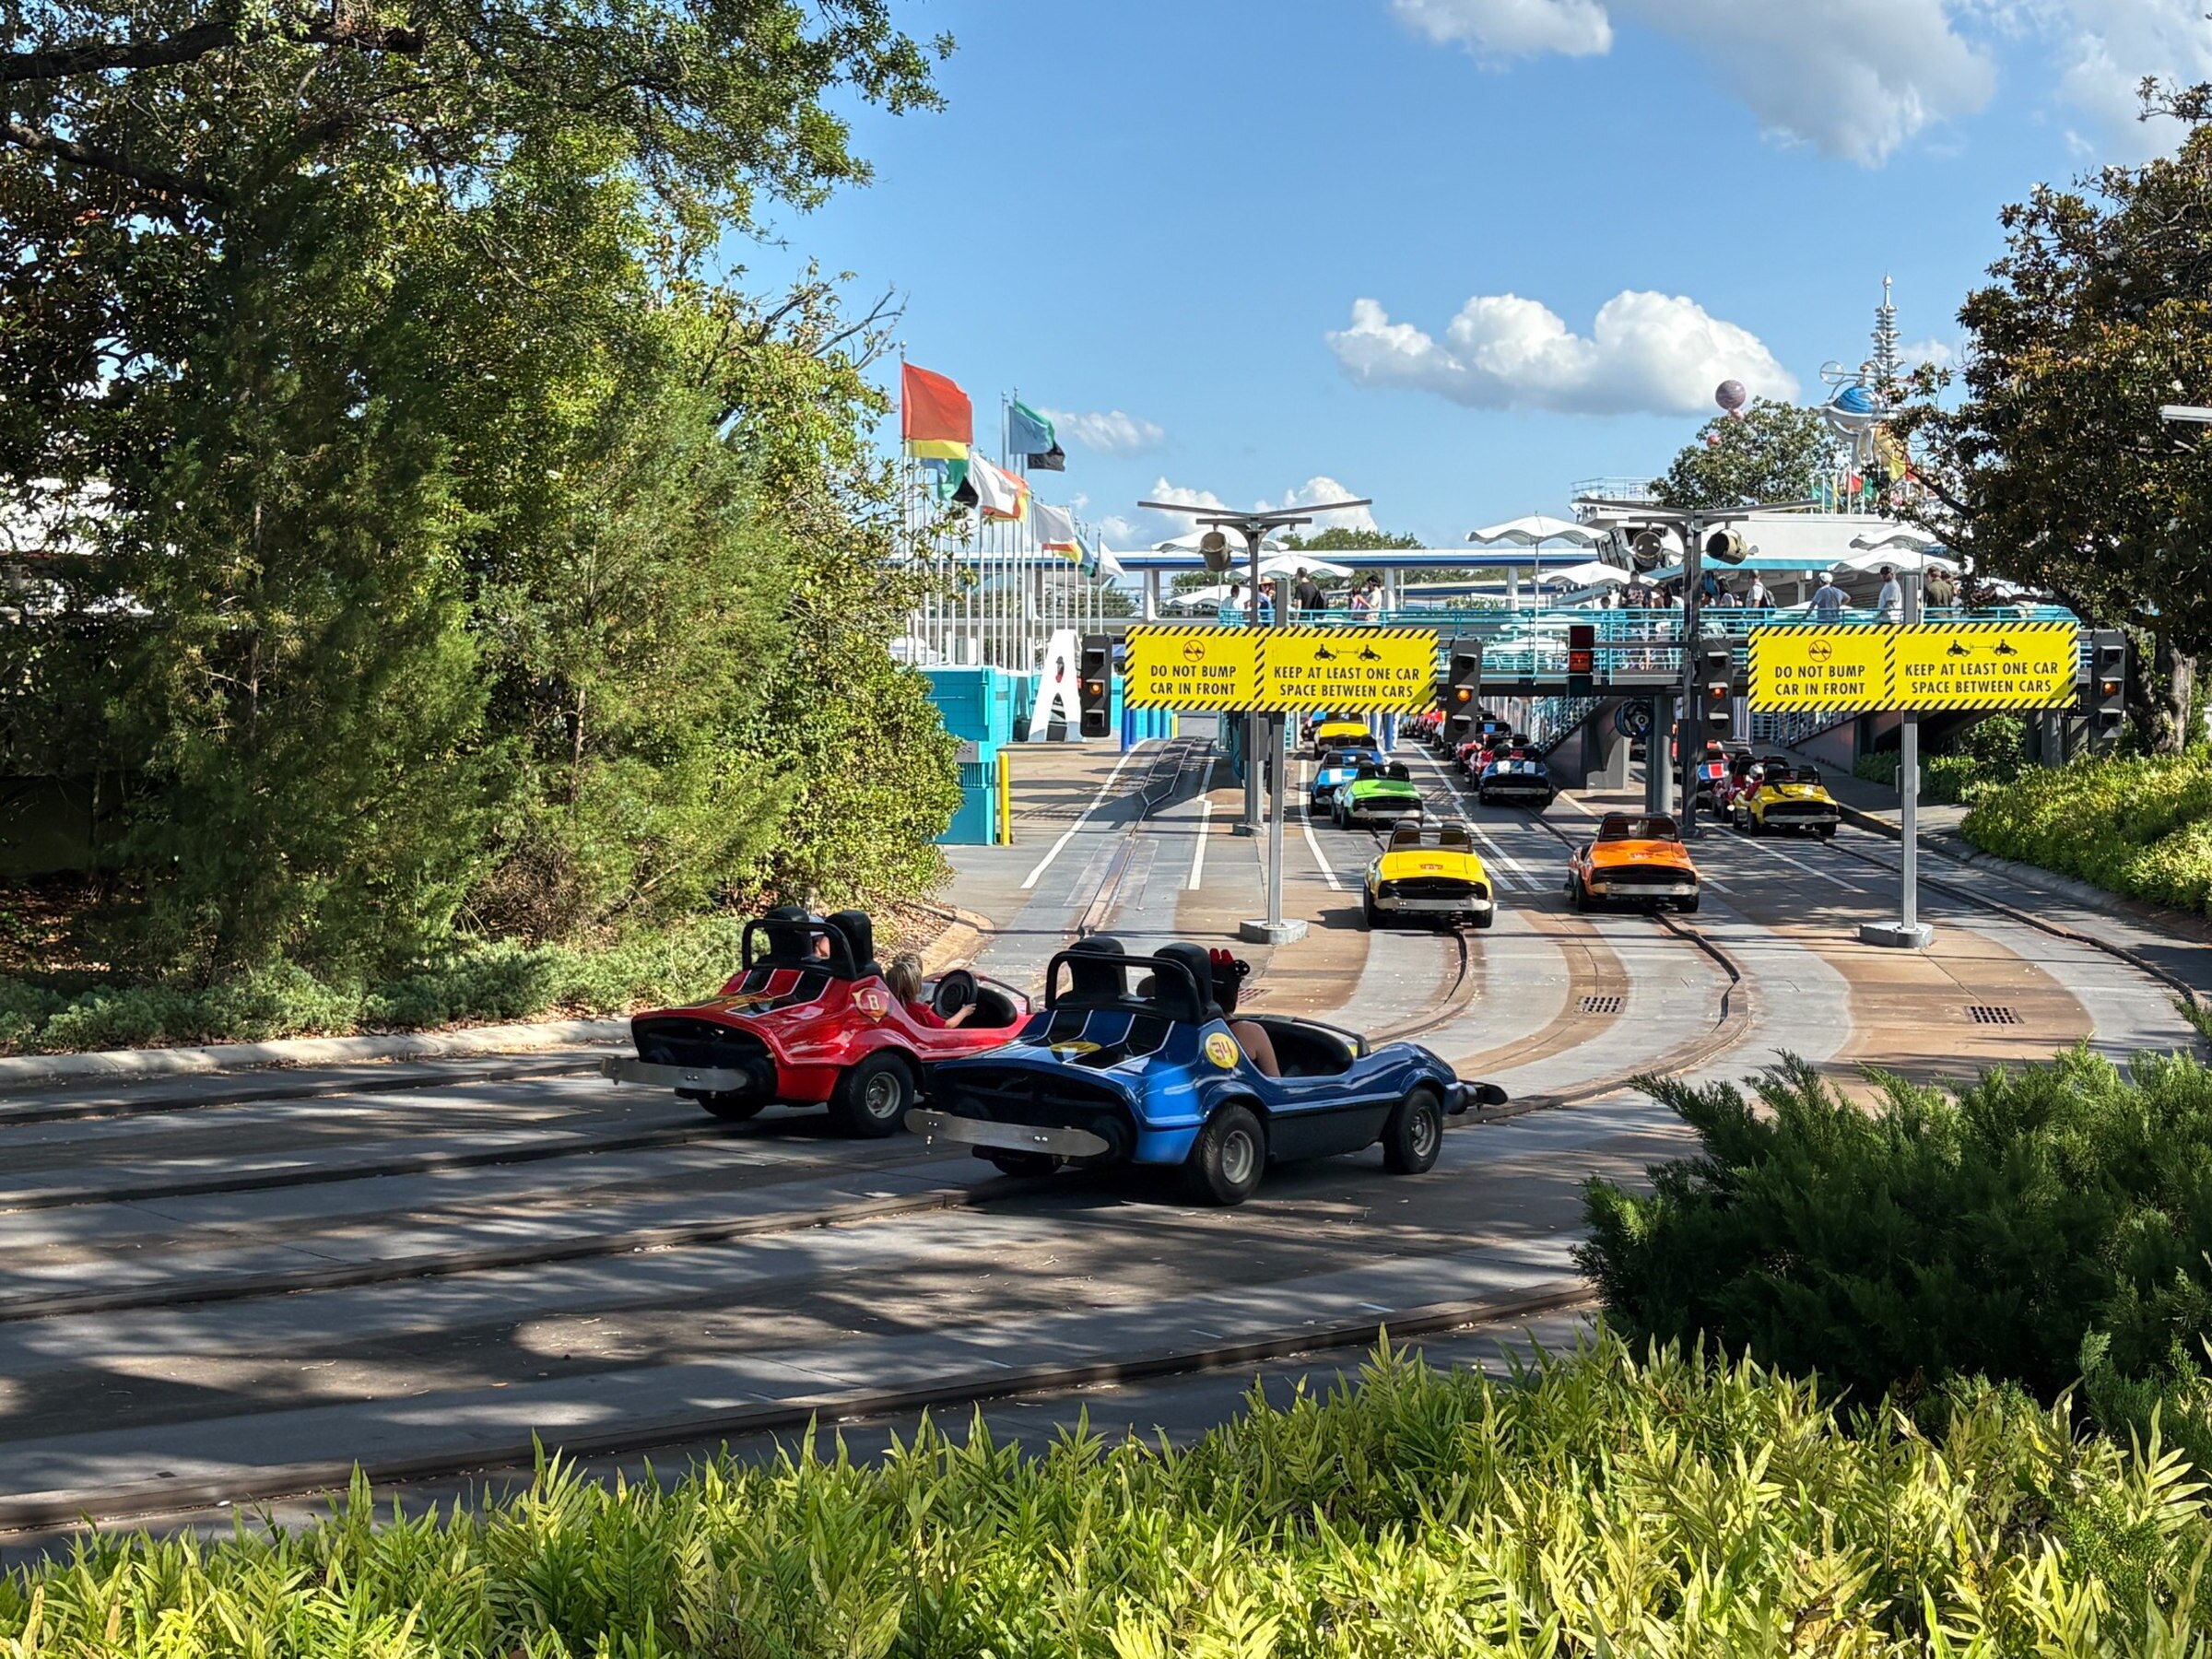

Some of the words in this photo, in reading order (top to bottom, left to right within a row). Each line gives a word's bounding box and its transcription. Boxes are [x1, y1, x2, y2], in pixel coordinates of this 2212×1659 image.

[1150, 665, 1168, 677] DO
[1172, 665, 1196, 677] NOT
[1202, 665, 1237, 678] BUMP
[1274, 665, 1303, 679] KEEP
[1307, 666, 1322, 679] AT
[1326, 666, 1361, 680] LEAST
[1366, 667, 1391, 680] ONE
[1395, 667, 1420, 681] CAR
[1775, 665, 1793, 678] DO
[1797, 665, 1823, 678] NOT
[1829, 665, 1865, 678] BUMP
[1905, 663, 1936, 677] KEEP
[1940, 663, 1956, 677] AT
[1960, 662, 1997, 676] LEAST
[2002, 662, 2029, 675] ONE
[2033, 662, 2058, 675] CAR
[1150, 682, 1173, 695] CAR
[1179, 682, 1191, 695] IN
[1196, 682, 1236, 696] FRONT
[1279, 683, 1317, 697] SPACE
[1321, 684, 1377, 698] BETWEEN
[1382, 685, 1414, 698] CARS
[1775, 683, 1799, 696] CAR
[1805, 682, 1818, 696] IN
[1823, 682, 1865, 696] FRONT
[1912, 680, 1950, 694] SPACE
[1955, 679, 2014, 694] BETWEEN
[2018, 679, 2052, 693] CARS
